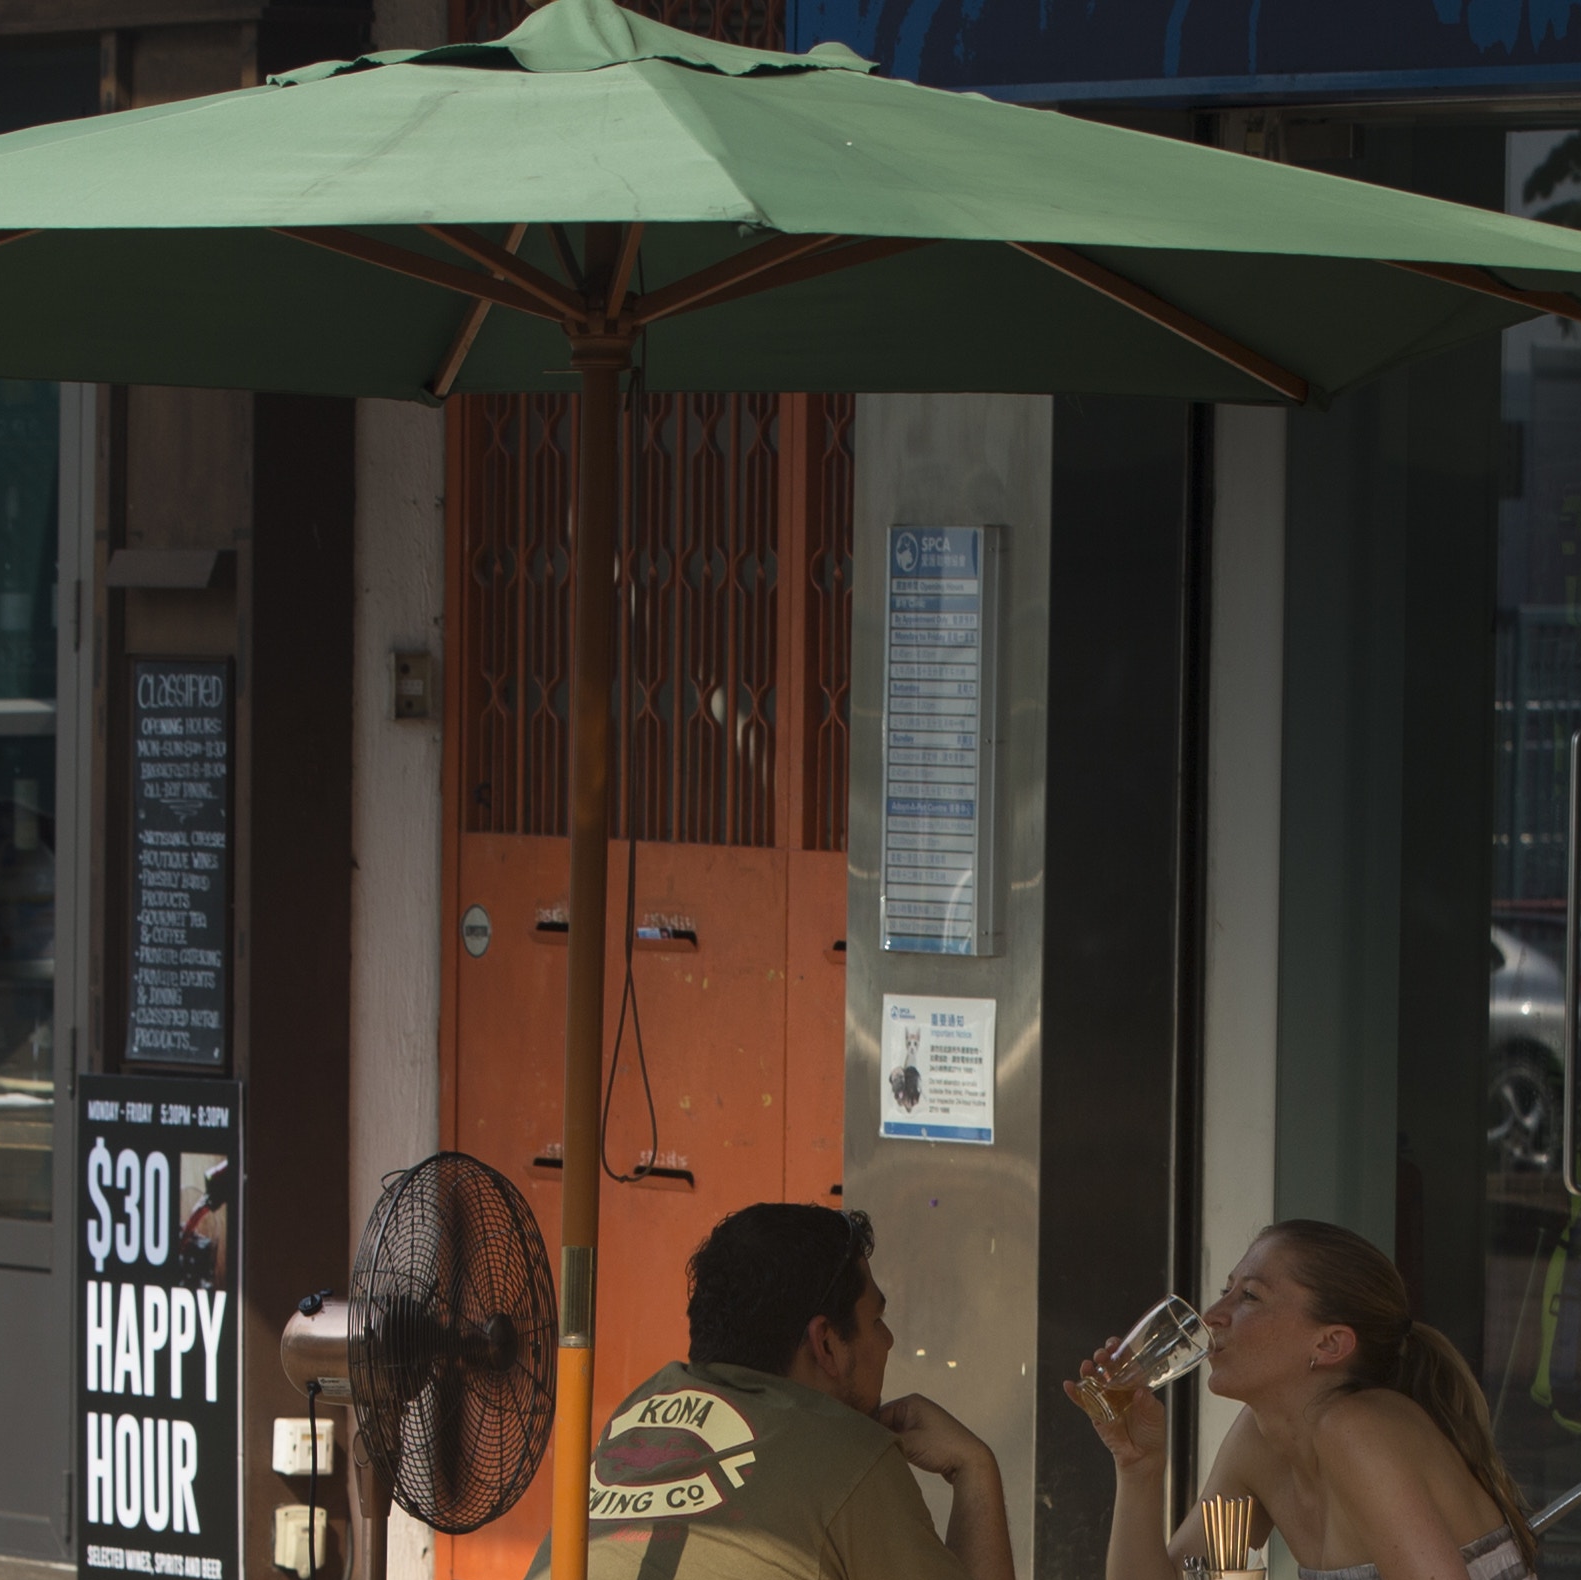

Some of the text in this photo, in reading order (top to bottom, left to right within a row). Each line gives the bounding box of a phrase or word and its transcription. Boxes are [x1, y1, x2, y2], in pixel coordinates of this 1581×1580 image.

[921, 536, 952, 553] SPCA
[87, 1099, 120, 1122] MONDAY
[125, 1100, 154, 1125] FRIDAY
[87, 1137, 170, 1273] $30
[87, 1280, 227, 1403] HAPPY
[637, 1396, 715, 1429] KONA
[87, 1411, 201, 1535] HOUR
[589, 1486, 654, 1516] WING
[87, 1544, 125, 1570] SELECTED
[154, 1552, 184, 1577] SPIRITS
[184, 1555, 201, 1578] AND
[201, 1557, 222, 1580] BEER
